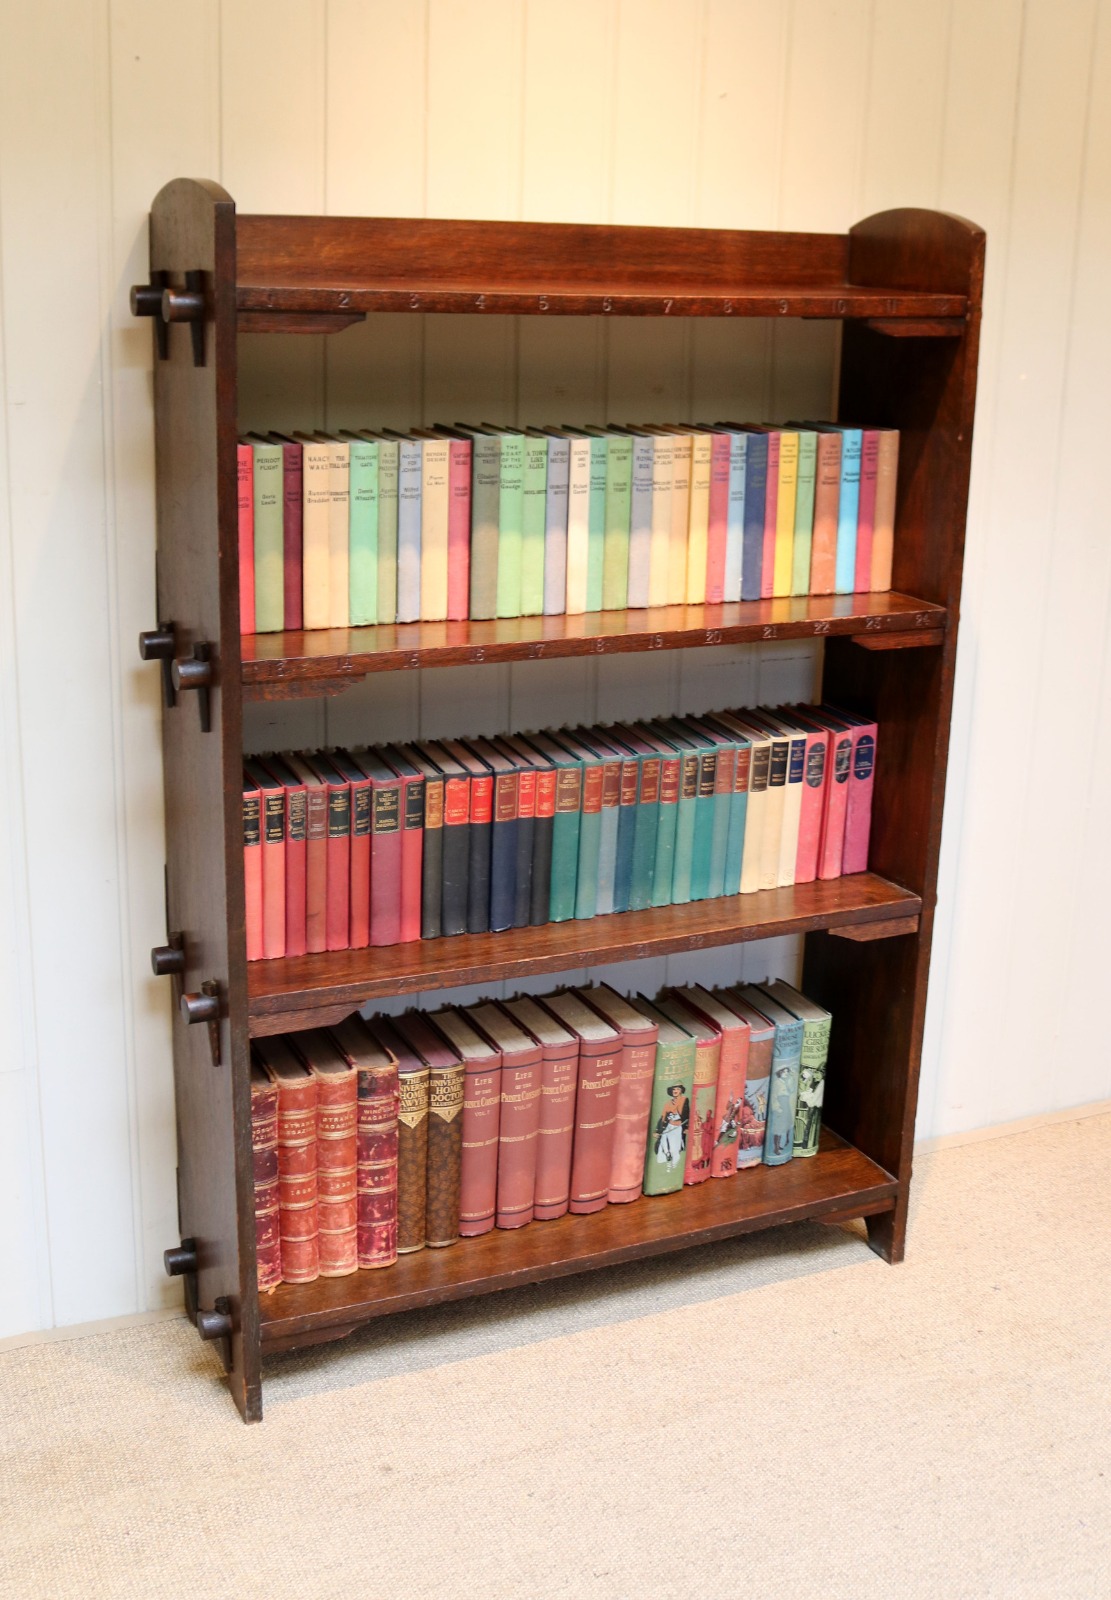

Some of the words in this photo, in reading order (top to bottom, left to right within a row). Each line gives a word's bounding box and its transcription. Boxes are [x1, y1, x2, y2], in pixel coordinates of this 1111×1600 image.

[337, 293, 350, 309] 2
[409, 293, 420, 309] 3
[475, 294, 486, 310] 4
[539, 296, 550, 311] 5
[602, 296, 612, 312] 6
[663, 299, 674, 314] 7
[778, 299, 789, 314] 9
[307, 455, 330, 463] NANCY
[528, 462, 545, 470] ALICE
[762, 625, 778, 639] 21
[813, 620, 831, 635] 22
[705, 629, 722, 644] 20
[528, 642, 546, 658] 17
[631, 1050, 649, 1059] LIFE
[553, 1064, 572, 1073] LIFE
[595, 1058, 614, 1068] LIFE
[406, 1077, 421, 1085] THE
[430, 1076, 464, 1087] UNIVERSA
[442, 1072, 457, 1080] THE
[474, 1077, 493, 1086] LIFE
[514, 1071, 533, 1081] LIFE
[400, 1089, 427, 1100] HOME
[436, 1084, 462, 1095] HOME
[400, 1096, 428, 1107] AWYER
[430, 1090, 464, 1102] DOCTOR
[363, 1105, 395, 1116] WINDSOR
[322, 1113, 355, 1123] STRAND
